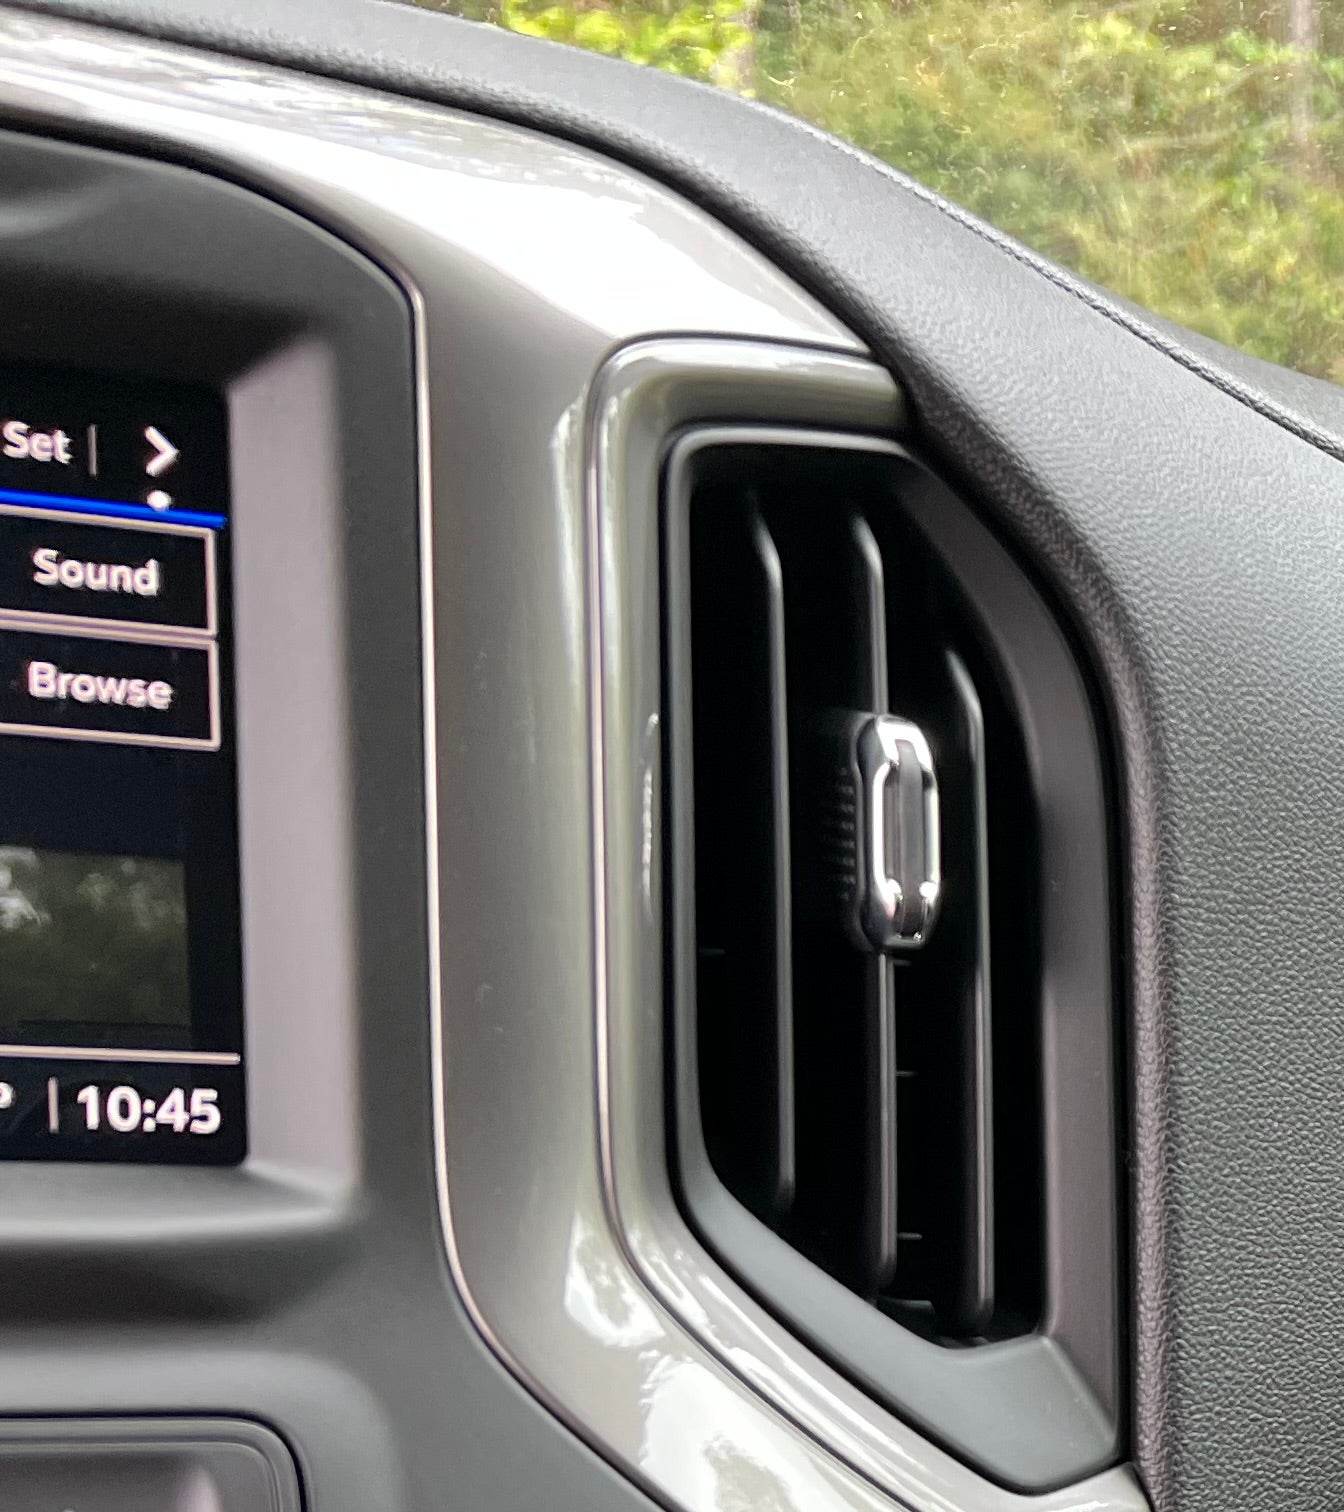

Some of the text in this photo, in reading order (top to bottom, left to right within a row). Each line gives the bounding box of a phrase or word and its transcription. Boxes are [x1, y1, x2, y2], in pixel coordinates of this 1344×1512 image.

[2, 420, 73, 465] Set
[32, 547, 161, 596] Sound
[27, 660, 174, 710] Browse
[77, 1085, 222, 1135] 10:45
